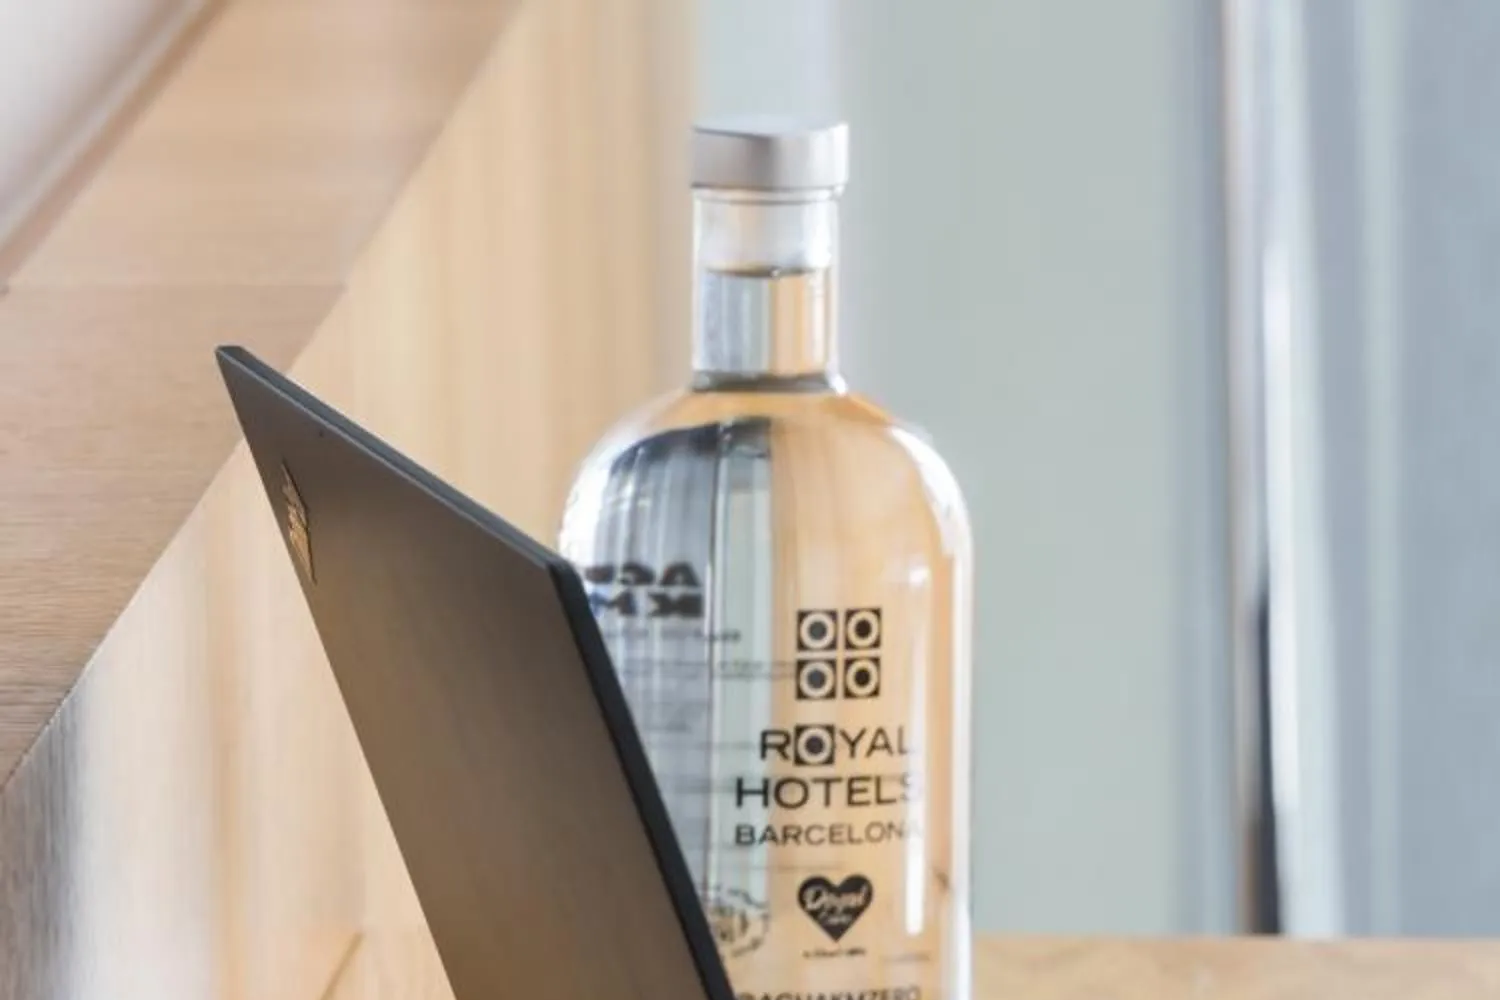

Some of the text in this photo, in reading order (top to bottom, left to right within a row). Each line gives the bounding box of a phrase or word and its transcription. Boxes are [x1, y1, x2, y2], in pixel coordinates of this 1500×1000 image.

[759, 723, 915, 766] ROYAL
[735, 773, 922, 810] HOTELS
[734, 820, 922, 847] BARCELON
